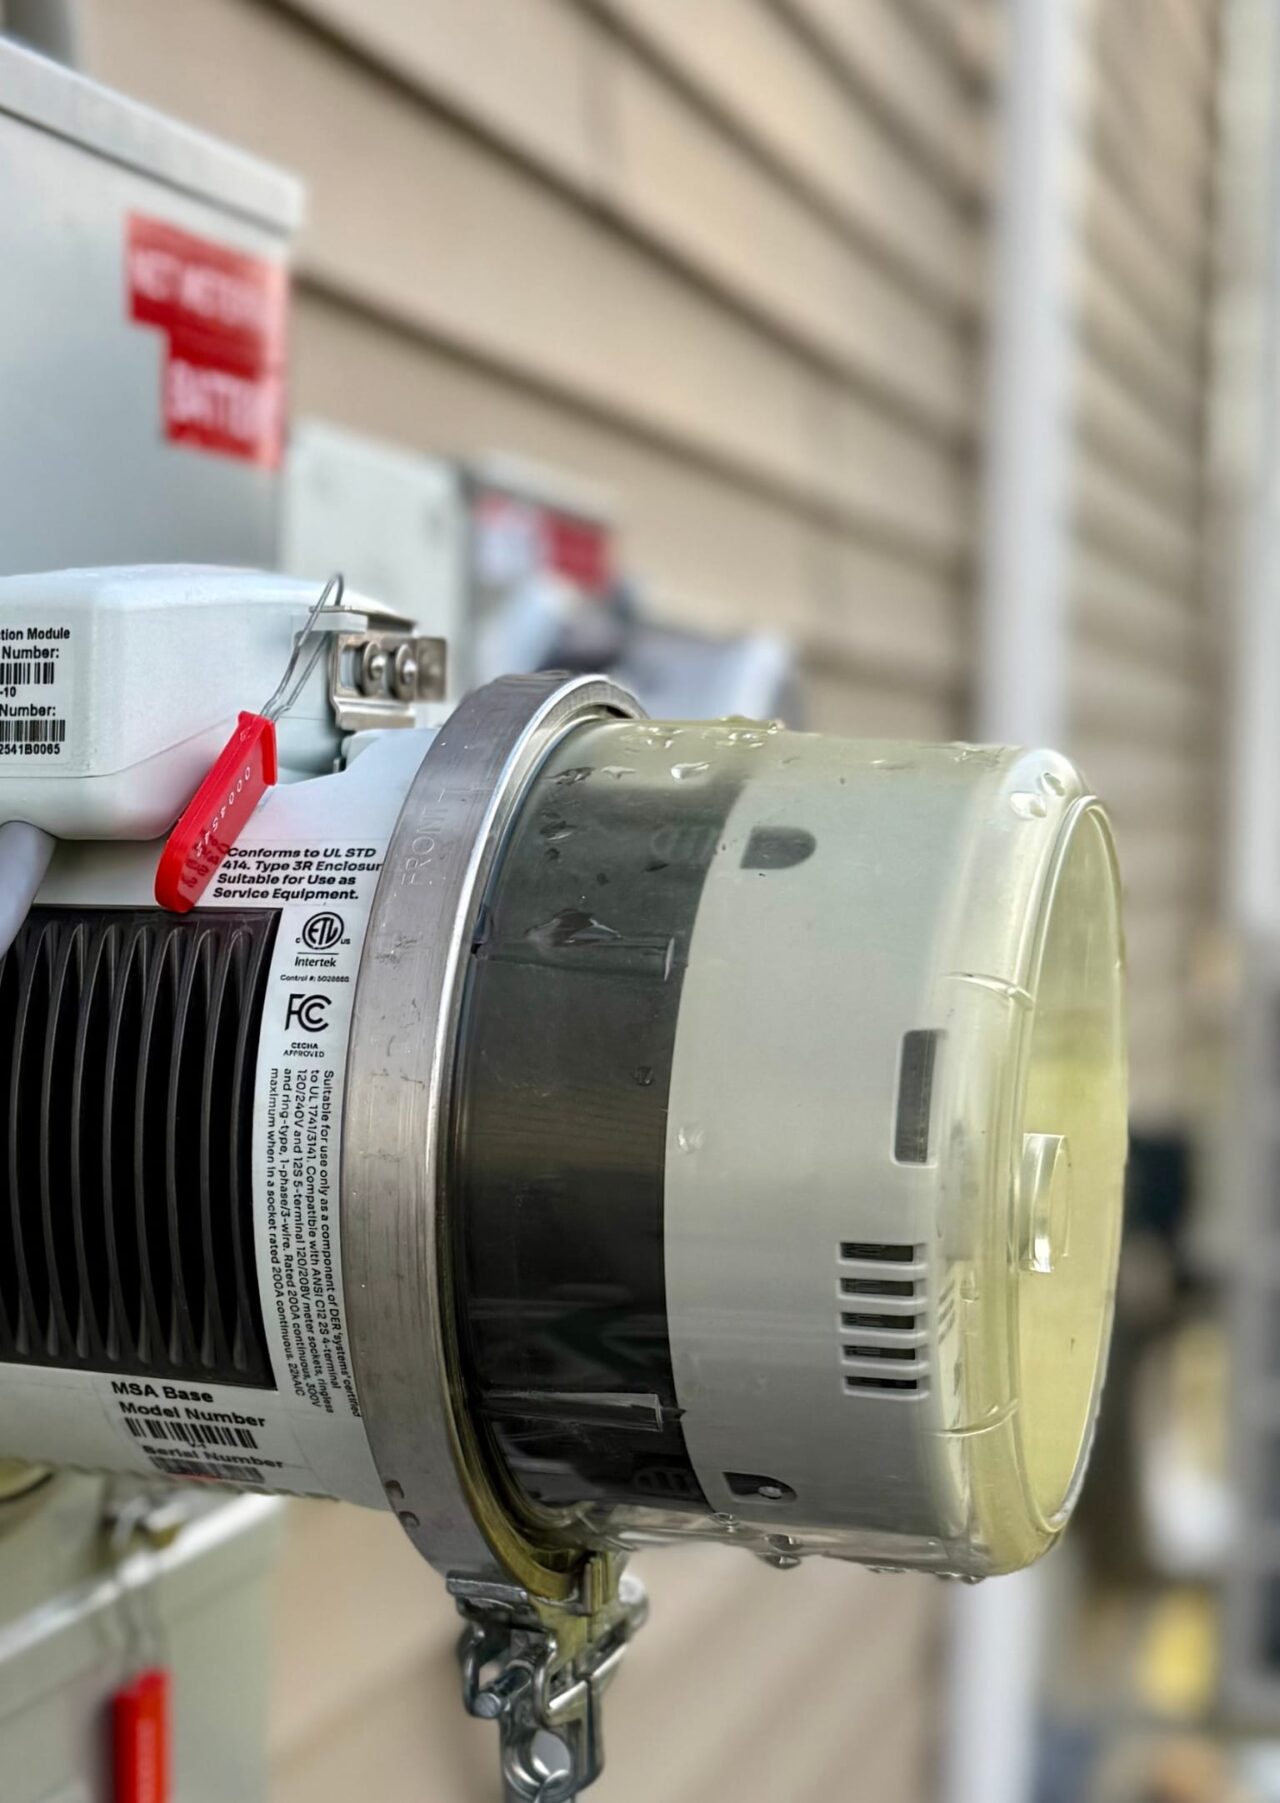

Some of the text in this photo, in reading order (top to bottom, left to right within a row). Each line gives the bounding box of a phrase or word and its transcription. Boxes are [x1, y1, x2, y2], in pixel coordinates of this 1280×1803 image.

[27, 626, 71, 641] Module
[1, 645, 60, 660] Number:
[227, 847, 378, 859] Conforms to UL STD
[217, 873, 357, 886] Suitable for Use as
[222, 860, 384, 873] 414. Type 3R Enclosur
[212, 887, 360, 901] Service Equipment.
[294, 955, 337, 967] Intertek
[283, 1068, 292, 1091] and
[310, 1069, 320, 1083] to
[267, 1068, 279, 1128] maximum
[294, 1069, 308, 1128] 120/240V
[308, 1086, 320, 1102] UL
[321, 1069, 335, 1122] Suitable
[279, 1094, 291, 1155] ring-type,
[320, 1124, 332, 1142] for
[267, 1130, 276, 1163] when
[293, 1130, 303, 1154] and
[293, 1157, 303, 1177] 12S
[319, 1145, 328, 1167] use
[267, 1166, 276, 1178] in
[318, 1169, 330, 1196] only
[267, 1190, 277, 1230] socket
[278, 1159, 291, 1251] 1-phase/3-wire.
[293, 1180, 305, 1244] 5-terminal
[305, 1165, 318, 1238] Compatible
[320, 1198, 328, 1212] as
[269, 1233, 281, 1264] rated
[309, 1240, 320, 1266] with
[321, 1223, 336, 1292] component
[272, 1266, 284, 1298] 200A
[284, 1254, 296, 1288] Rated
[296, 1246, 311, 1301] 120/208V
[311, 1267, 324, 1297] ANSI
[287, 1290, 300, 1320] 200A
[327, 1294, 338, 1307] of
[303, 1302, 314, 1334] meter
[318, 1321, 330, 1335] 2S
[329, 1308, 342, 1331] DER
[322, 1337, 341, 1389] 4-terminal
[111, 1381, 214, 1403] MSA Base
[317, 1378, 334, 1413] ringless
[119, 1401, 266, 1427] Model Number
[142, 1445, 199, 1459] Serial
[203, 1451, 283, 1468] Number
